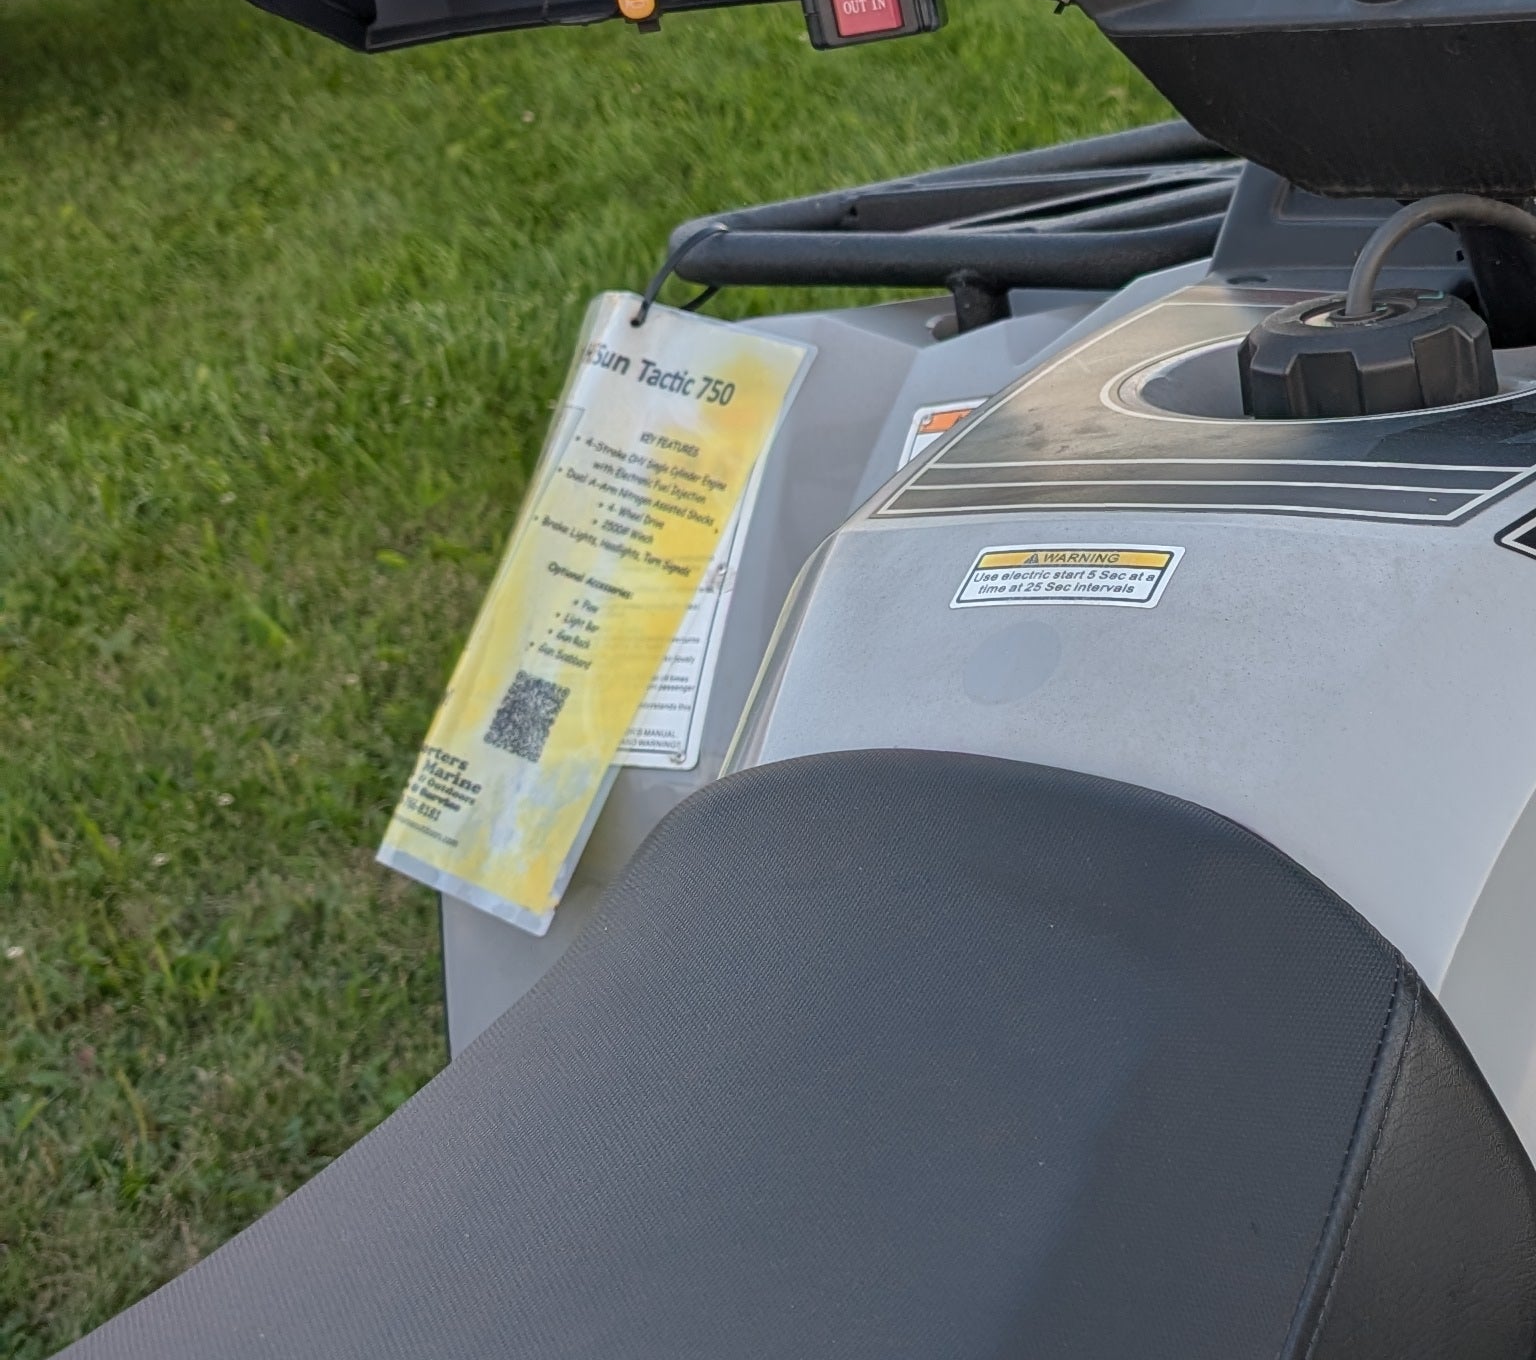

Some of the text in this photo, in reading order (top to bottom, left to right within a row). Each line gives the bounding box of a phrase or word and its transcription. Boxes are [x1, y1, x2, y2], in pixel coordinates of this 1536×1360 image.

[638, 359, 695, 396] Tactic
[696, 376, 736, 406] 750
[1043, 552, 1121, 564] WARNING
[973, 569, 1156, 583] Use electric start 5 Sec at a
[978, 582, 1136, 595] time at 25 Sec intervals
[423, 760, 482, 794] Marine
